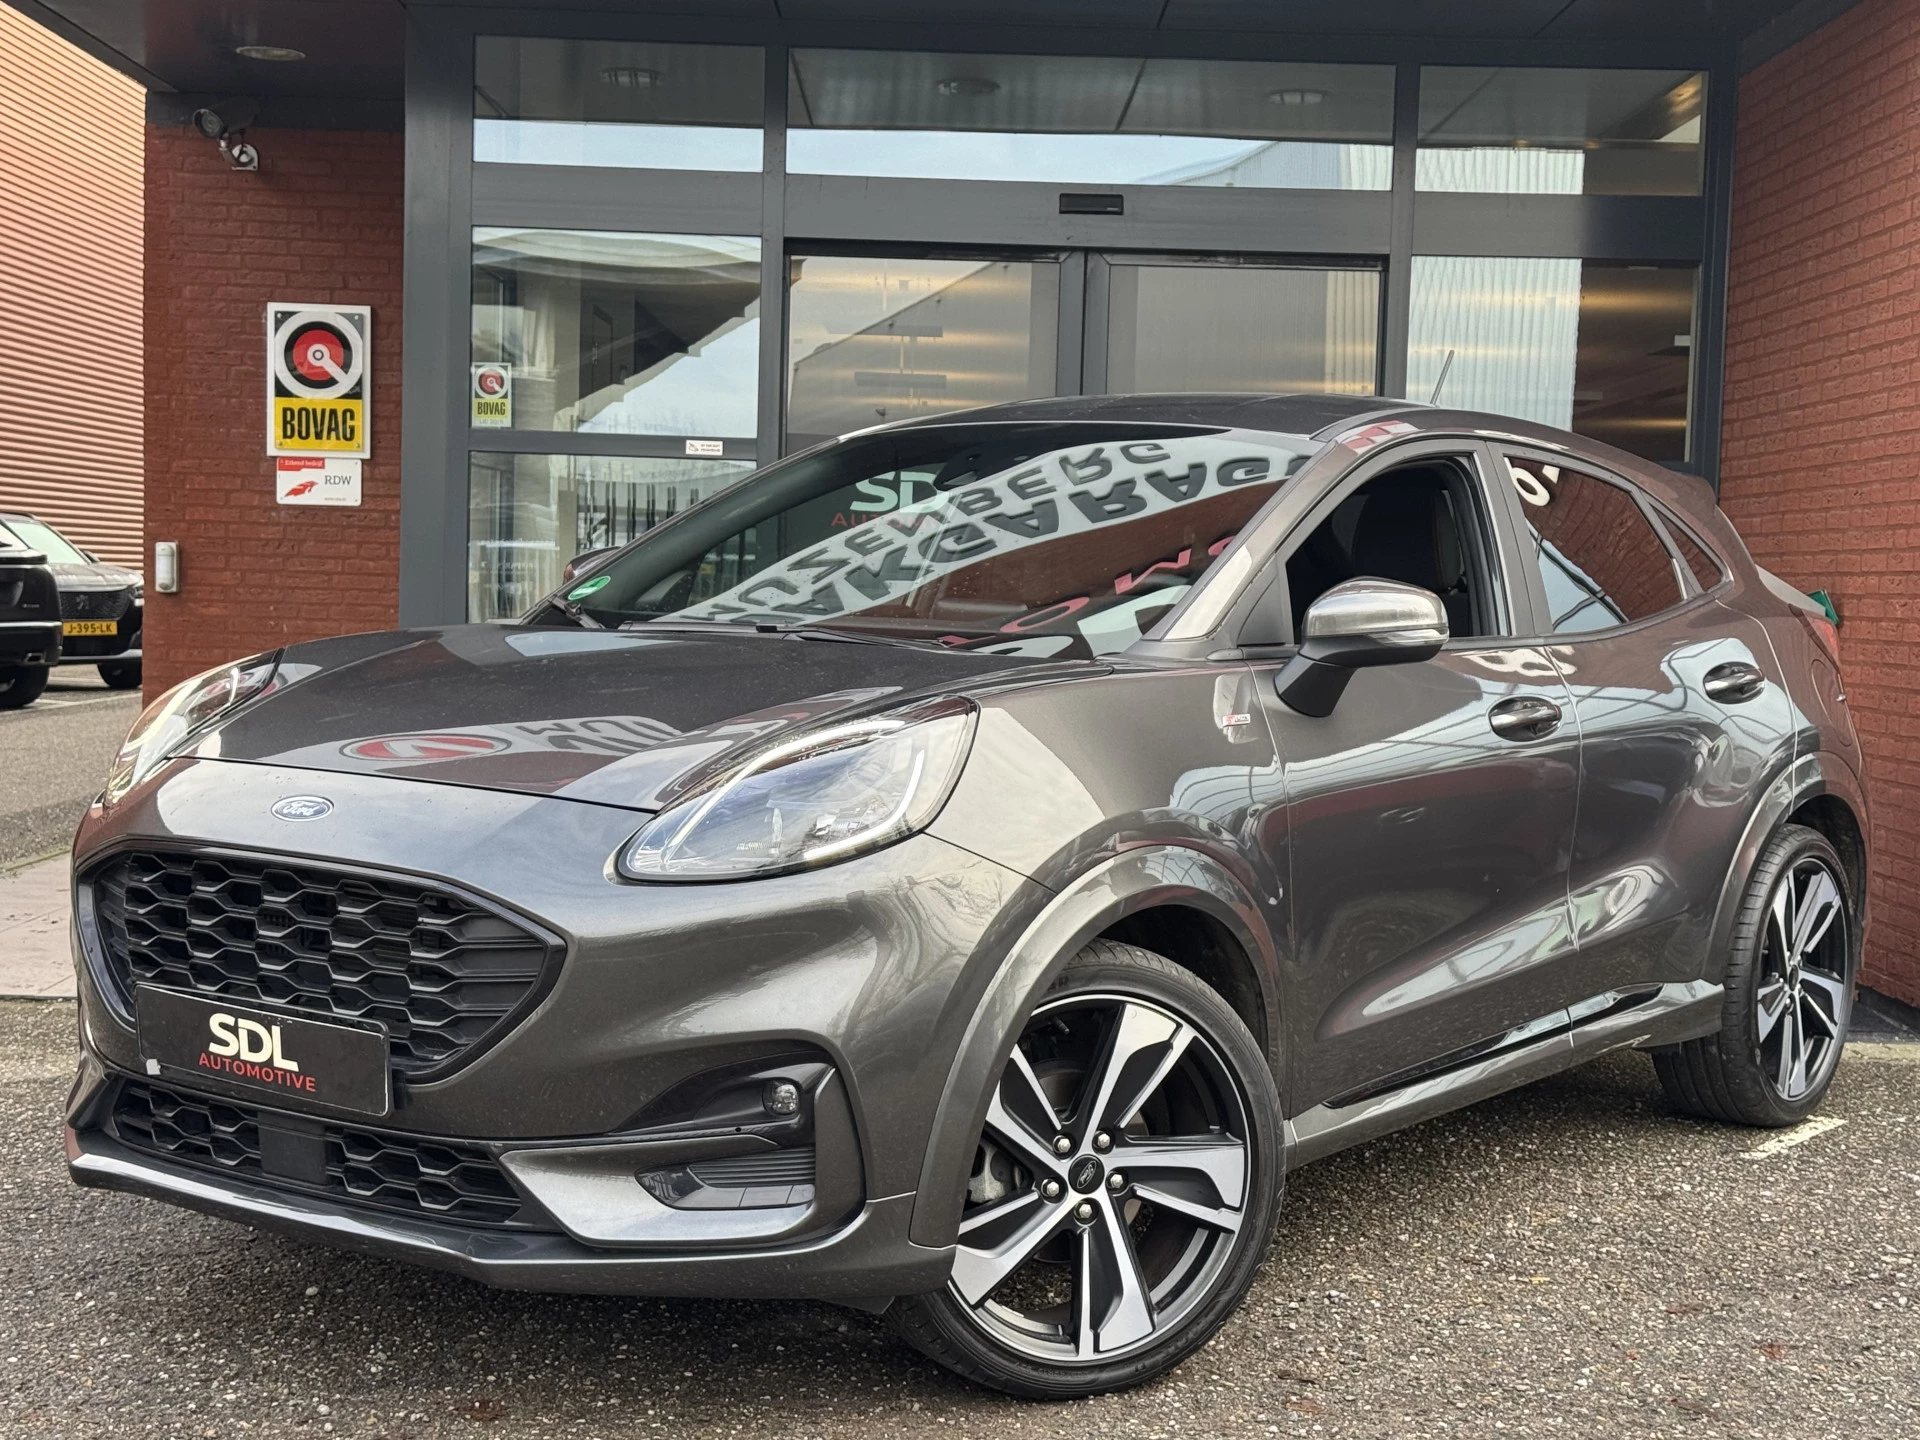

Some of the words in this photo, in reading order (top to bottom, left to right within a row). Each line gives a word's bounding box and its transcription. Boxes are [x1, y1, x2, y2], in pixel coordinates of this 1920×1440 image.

[281, 406, 356, 443] BOVAG
[477, 401, 506, 416] BOVAG
[324, 475, 352, 486] RDW
[849, 470, 951, 514] SD
[67, 623, 113, 633] J-395-LK
[208, 1012, 300, 1073] SDL
[198, 1052, 317, 1093] AUTOMOTIVE
